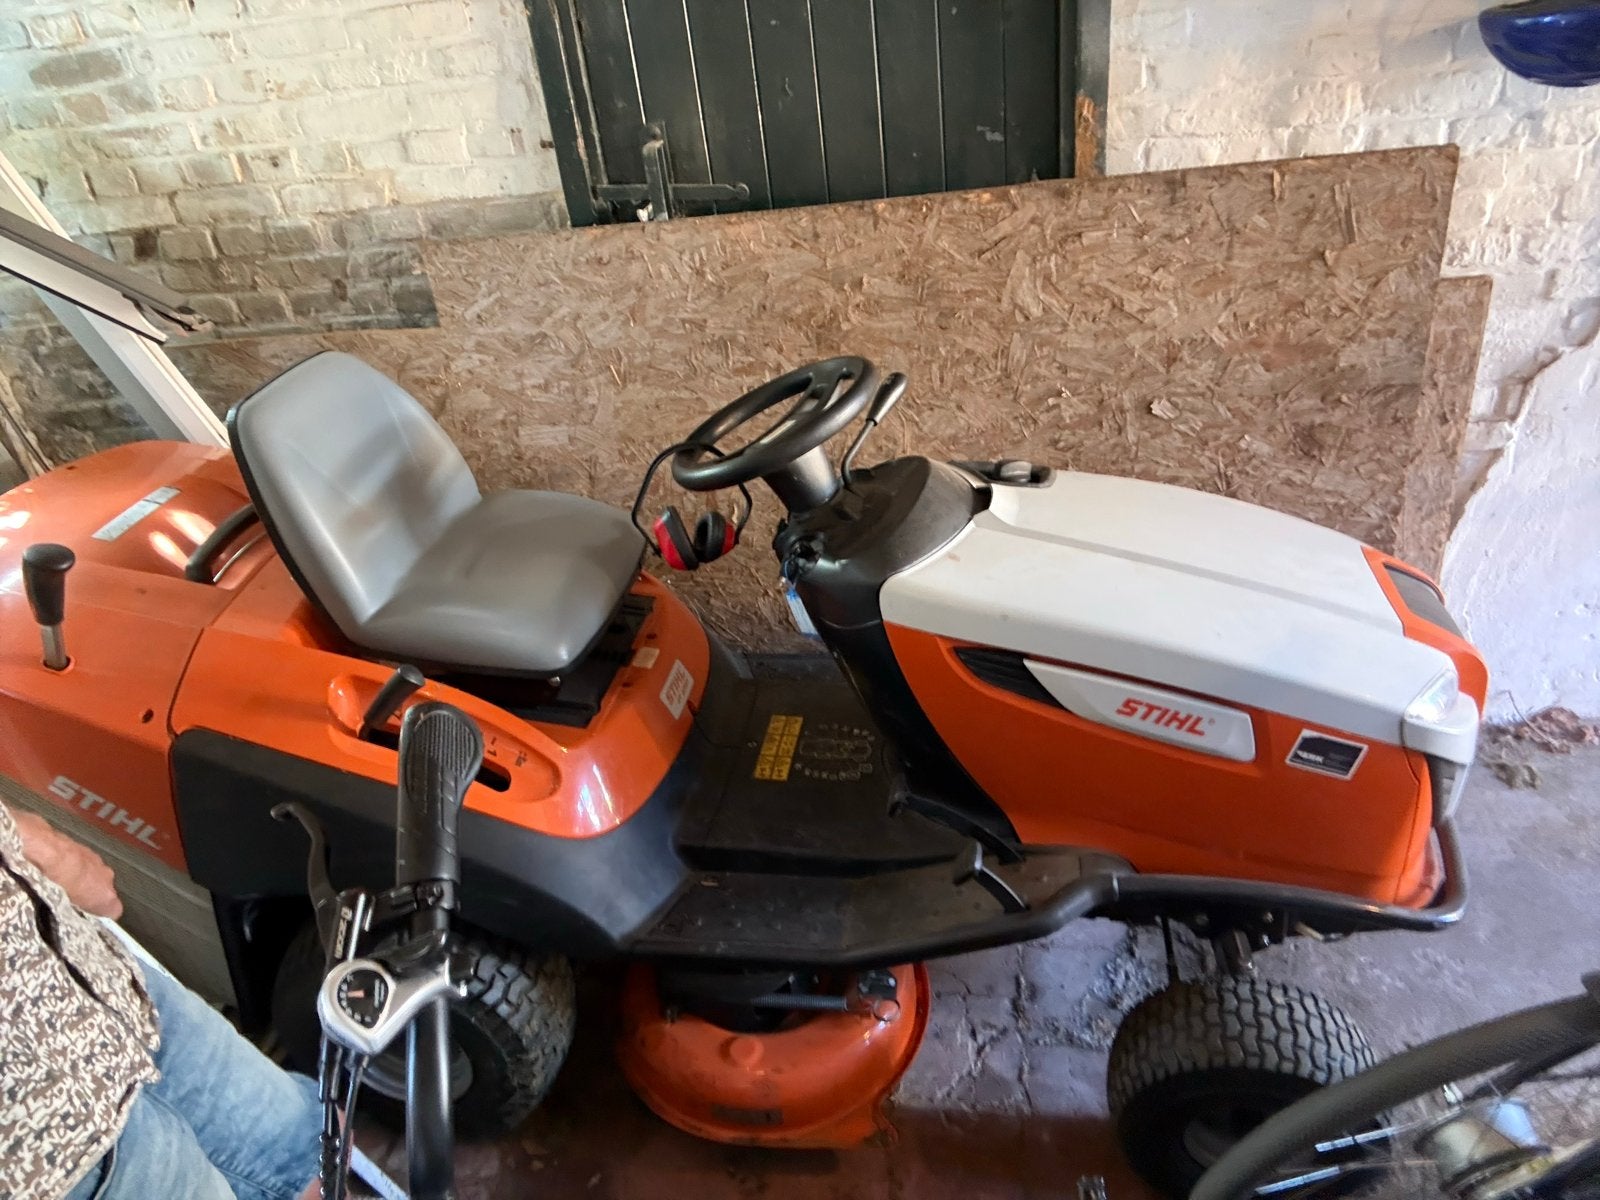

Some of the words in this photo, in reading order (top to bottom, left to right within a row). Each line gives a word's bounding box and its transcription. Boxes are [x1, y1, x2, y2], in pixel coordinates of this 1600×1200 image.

[664, 669, 686, 705] STIHL
[1115, 697, 1205, 736] STIHL
[47, 775, 161, 851] STIHL
